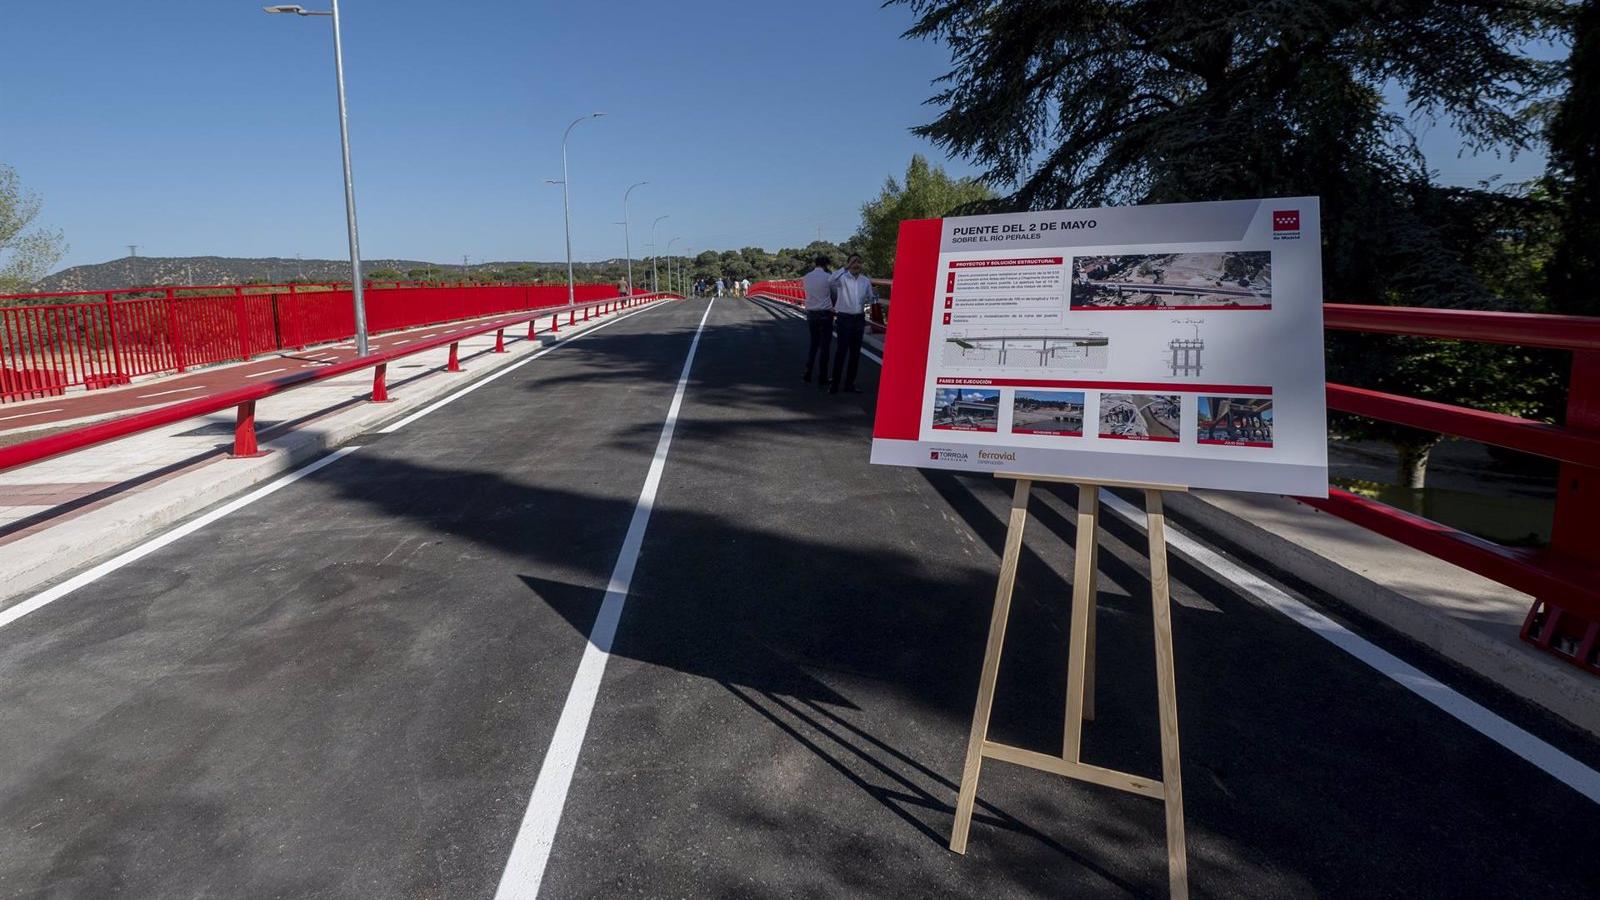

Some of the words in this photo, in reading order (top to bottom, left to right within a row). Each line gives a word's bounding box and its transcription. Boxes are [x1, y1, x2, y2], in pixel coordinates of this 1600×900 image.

[953, 225, 999, 235] PUENTE
[1002, 224, 1025, 233] DEL
[1029, 223, 1036, 231] 2
[1040, 222, 1057, 231] DE
[1061, 220, 1097, 230] MAYO
[952, 235, 977, 244] SOBRE
[1005, 233, 1041, 241] PERALES
[940, 451, 968, 459] TORROJA
[978, 449, 1016, 461] ferrovial
